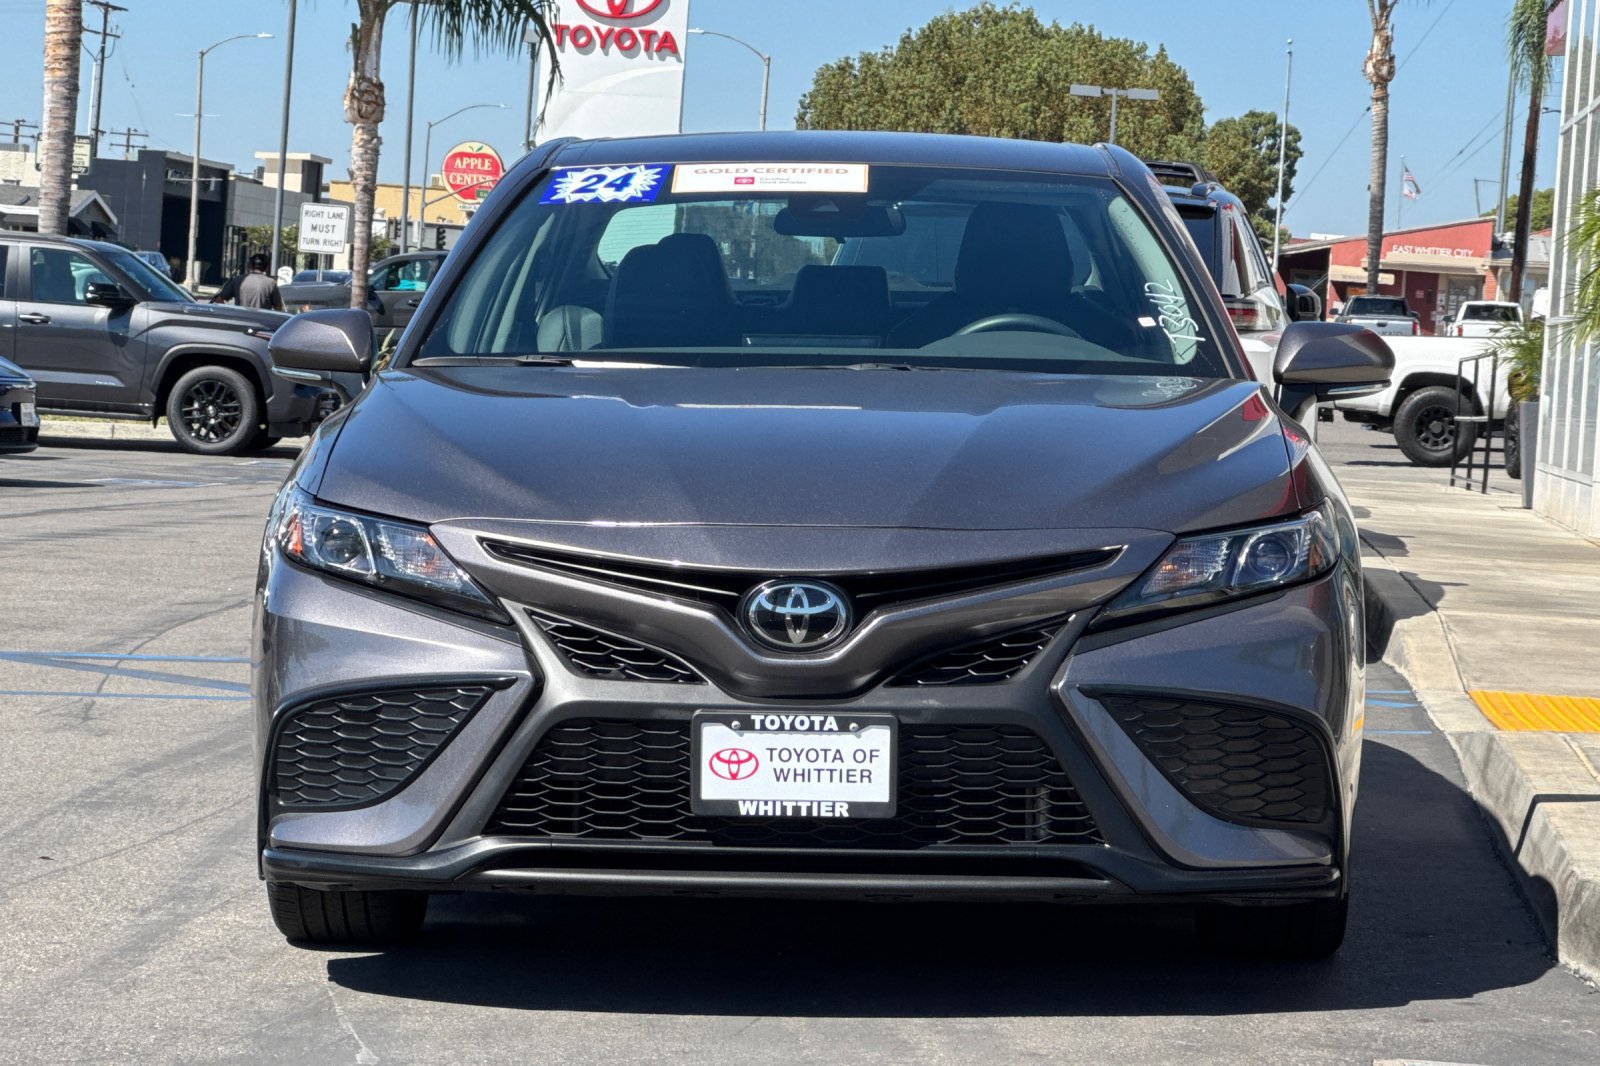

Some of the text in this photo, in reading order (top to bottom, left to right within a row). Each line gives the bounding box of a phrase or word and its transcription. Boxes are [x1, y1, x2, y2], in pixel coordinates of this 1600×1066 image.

[551, 23, 678, 54] TOYOTA
[454, 157, 492, 171] APPLE
[450, 172, 493, 187] CENTER
[571, 172, 637, 194] 24
[304, 209, 345, 220] RIGHT LANE
[311, 223, 336, 233] MUST
[302, 236, 343, 247] TURN RIGHT
[1391, 244, 1474, 257] EAST WHITTIER CITY
[751, 715, 839, 731] TOYOTA
[766, 747, 880, 764] TOYOTA OF
[773, 768, 873, 784] WHITTIER
[738, 800, 850, 817] WHITTIER
